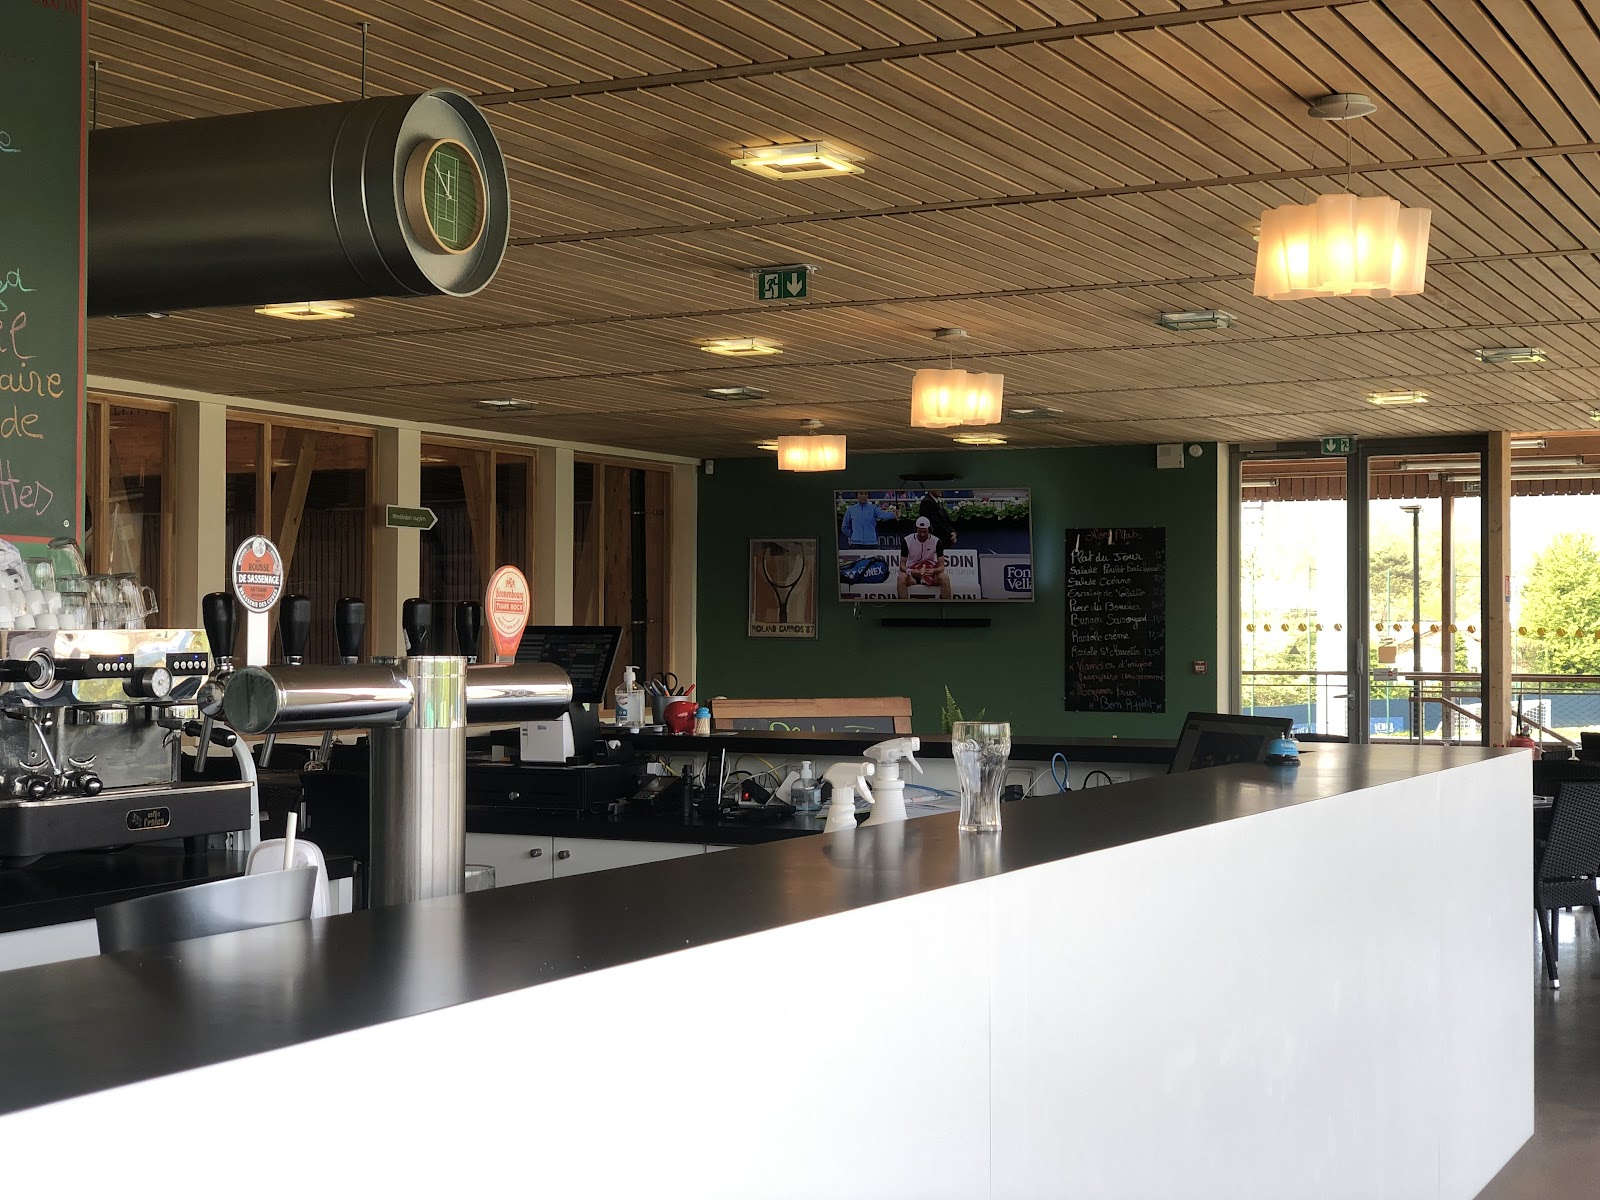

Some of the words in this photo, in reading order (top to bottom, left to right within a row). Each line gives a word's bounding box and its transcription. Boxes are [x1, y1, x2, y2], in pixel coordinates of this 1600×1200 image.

[249, 563, 269, 572] ROUSSE
[239, 574, 247, 583] DE
[247, 574, 280, 585] SASSENAGE
